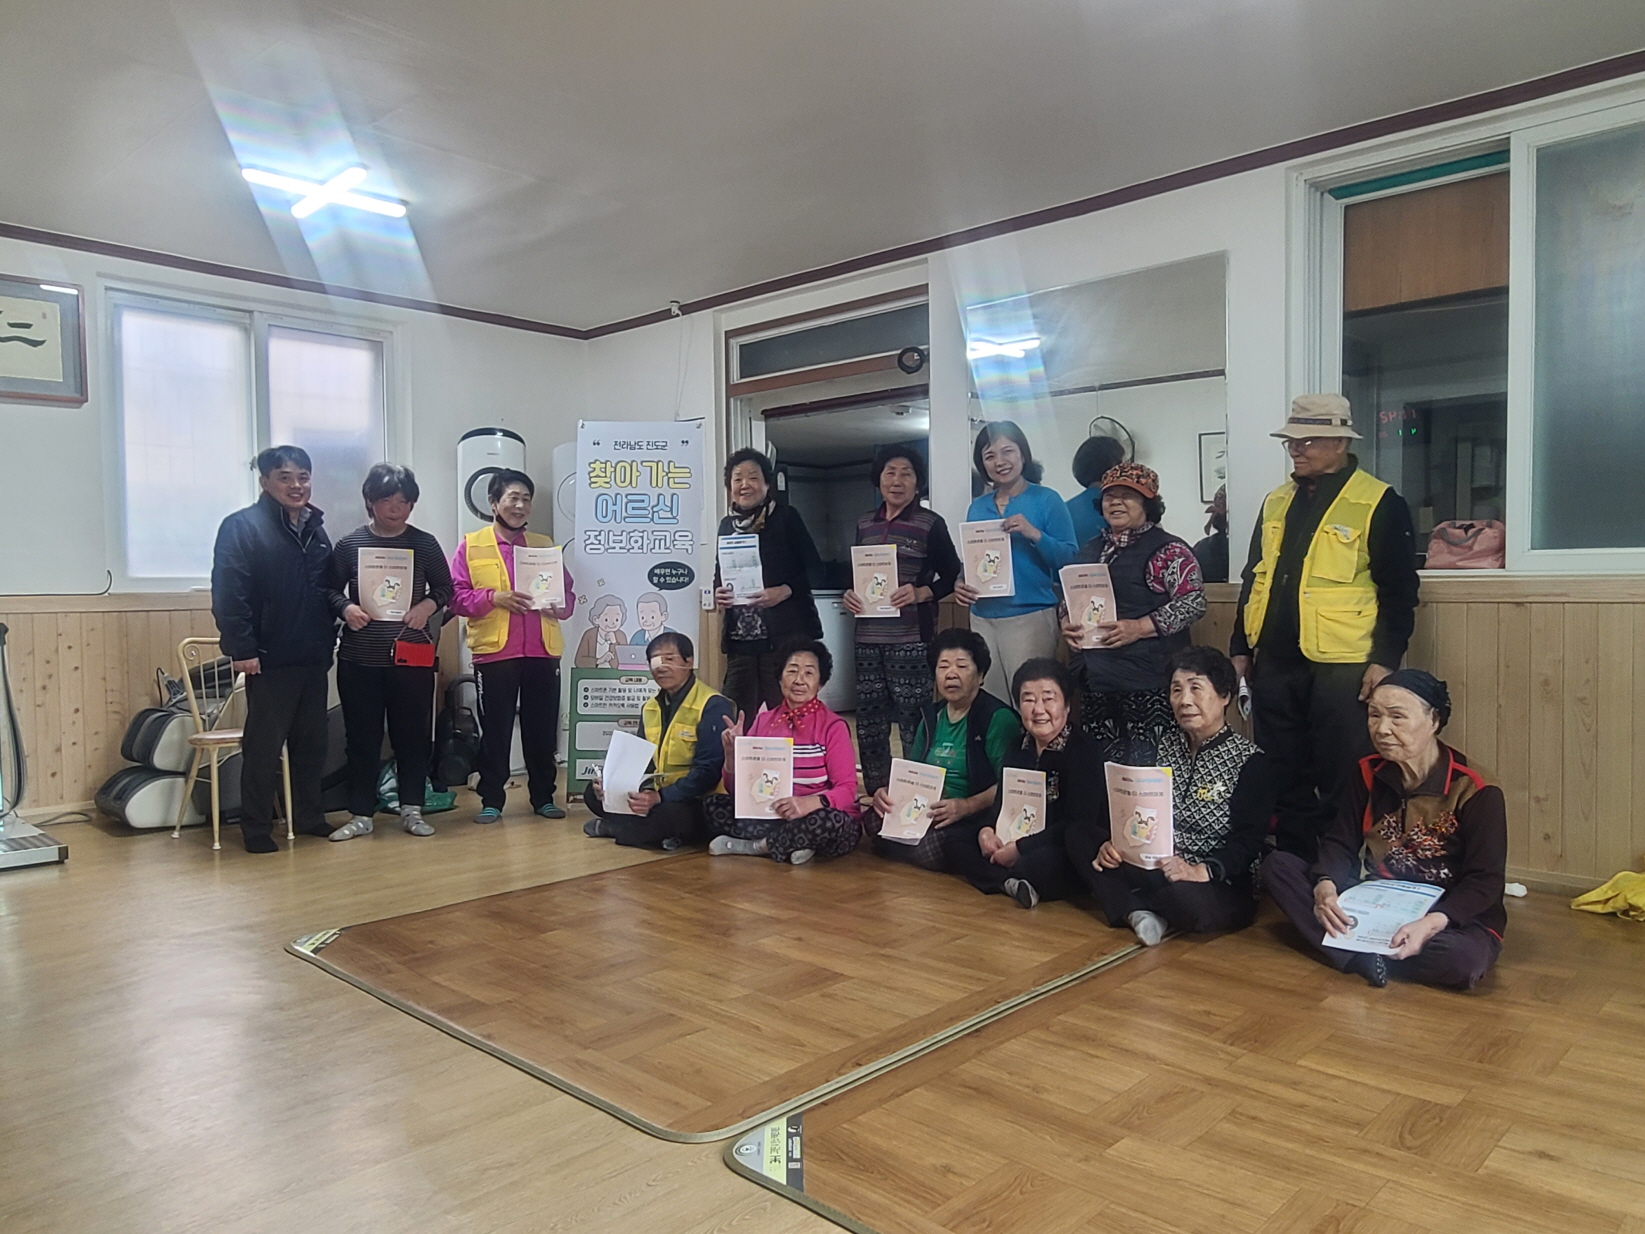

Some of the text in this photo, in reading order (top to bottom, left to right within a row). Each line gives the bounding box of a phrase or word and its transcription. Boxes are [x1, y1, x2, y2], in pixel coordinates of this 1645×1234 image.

[613, 440, 668, 450] 전라남도 진도군
[588, 459, 692, 489] 찾아가는
[595, 493, 679, 524] 어르신
[584, 529, 695, 555] 정보화교육
